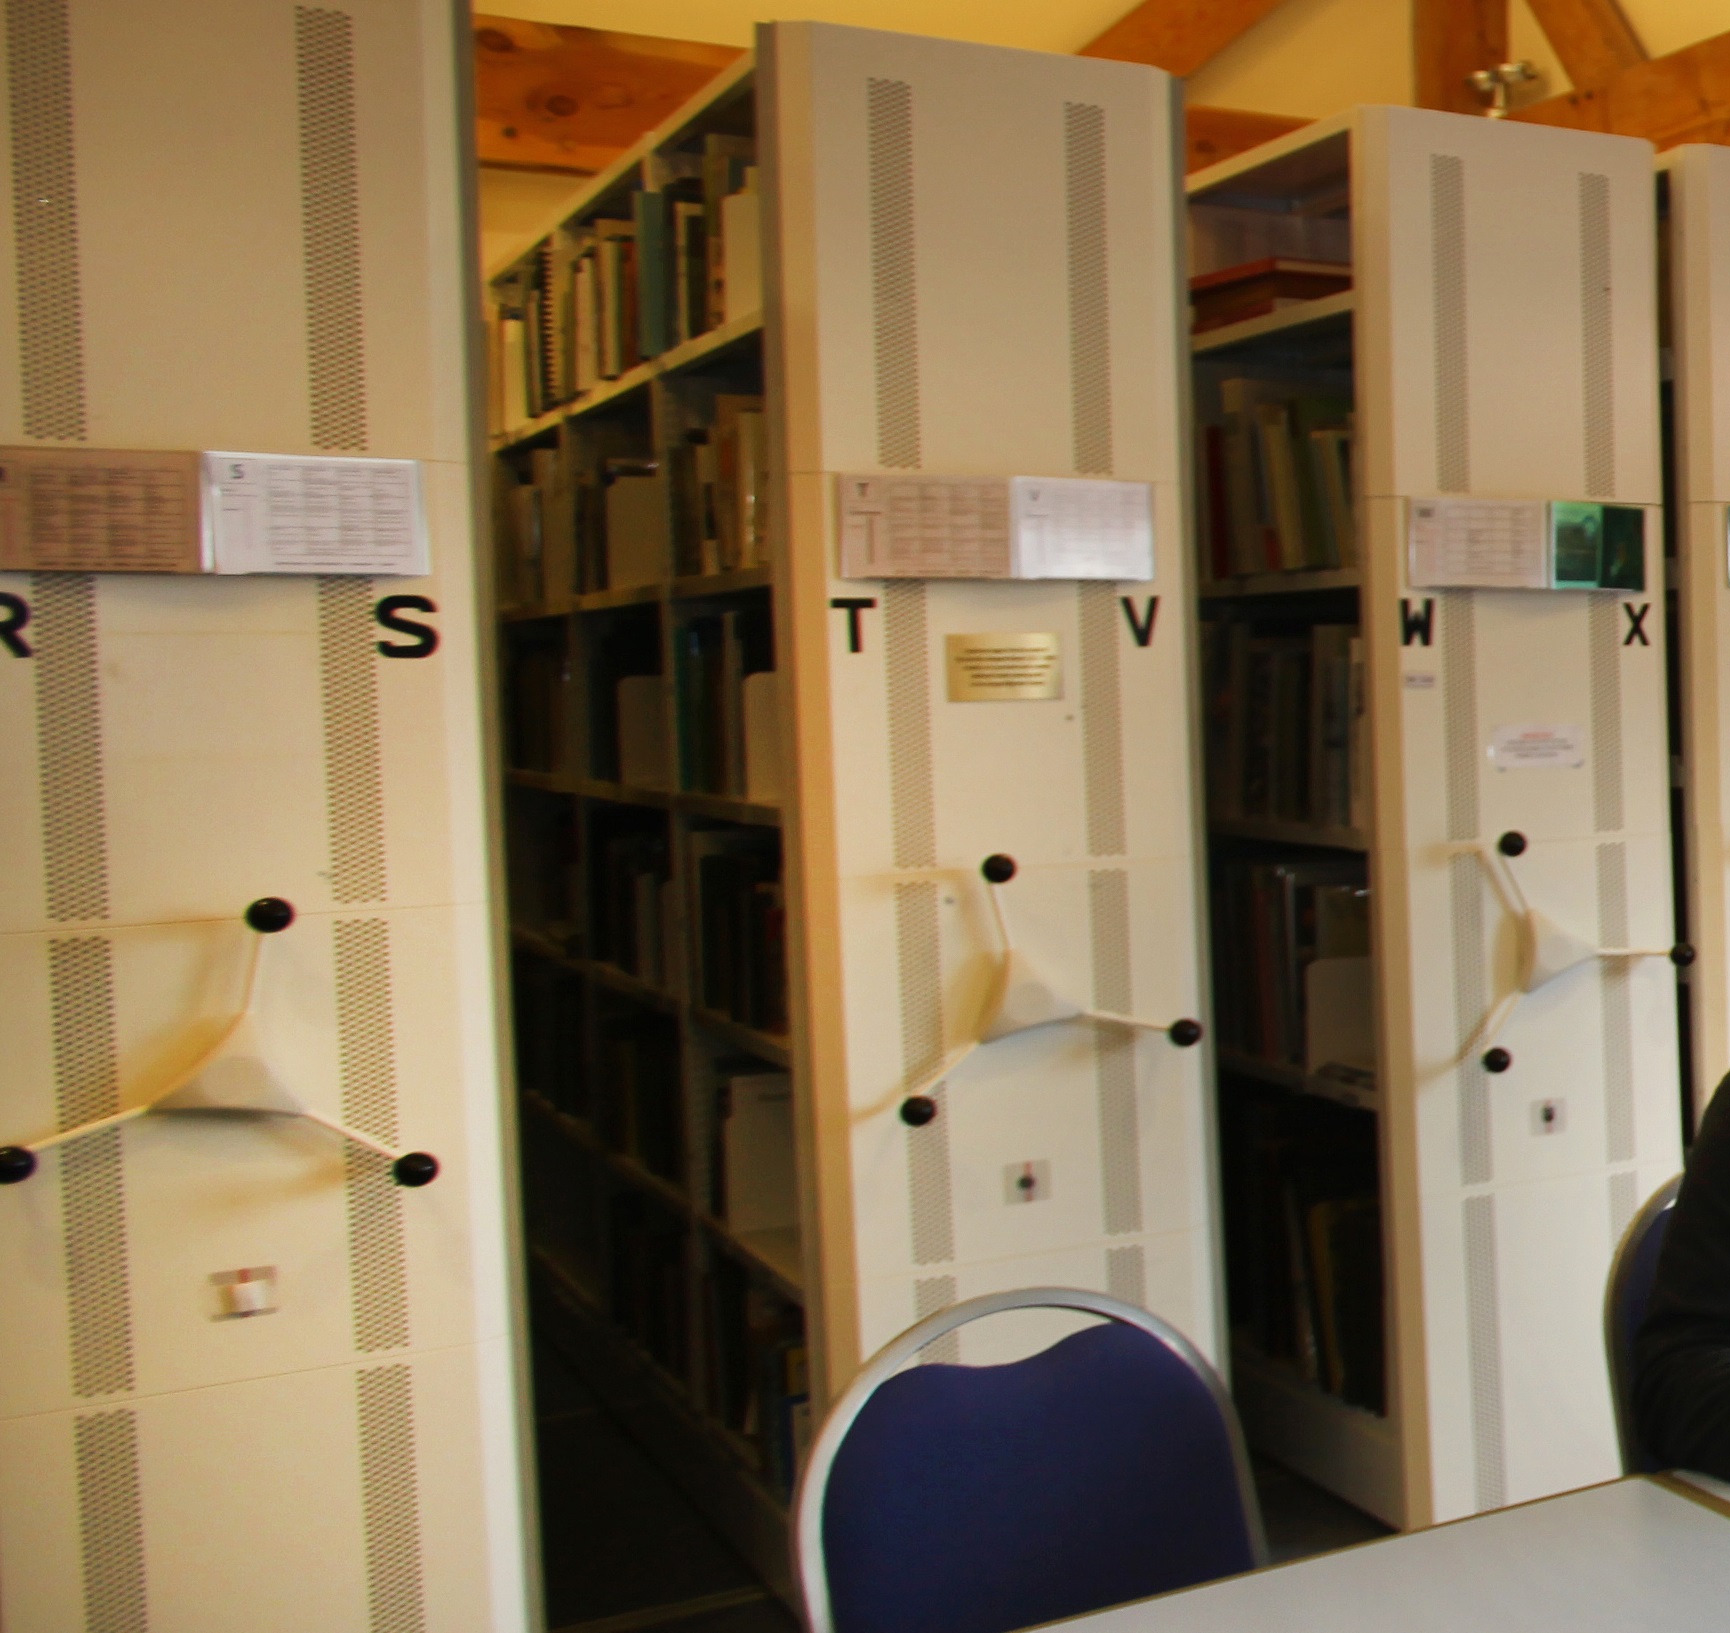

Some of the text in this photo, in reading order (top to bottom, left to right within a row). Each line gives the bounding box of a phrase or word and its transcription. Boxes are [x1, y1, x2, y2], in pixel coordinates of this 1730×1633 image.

[230, 464, 245, 480] S
[376, 594, 440, 659] S
[830, 598, 877, 653] T
[1121, 596, 1160, 647] V
[1400, 599, 1435, 647] W
[1623, 603, 1651, 646] X
